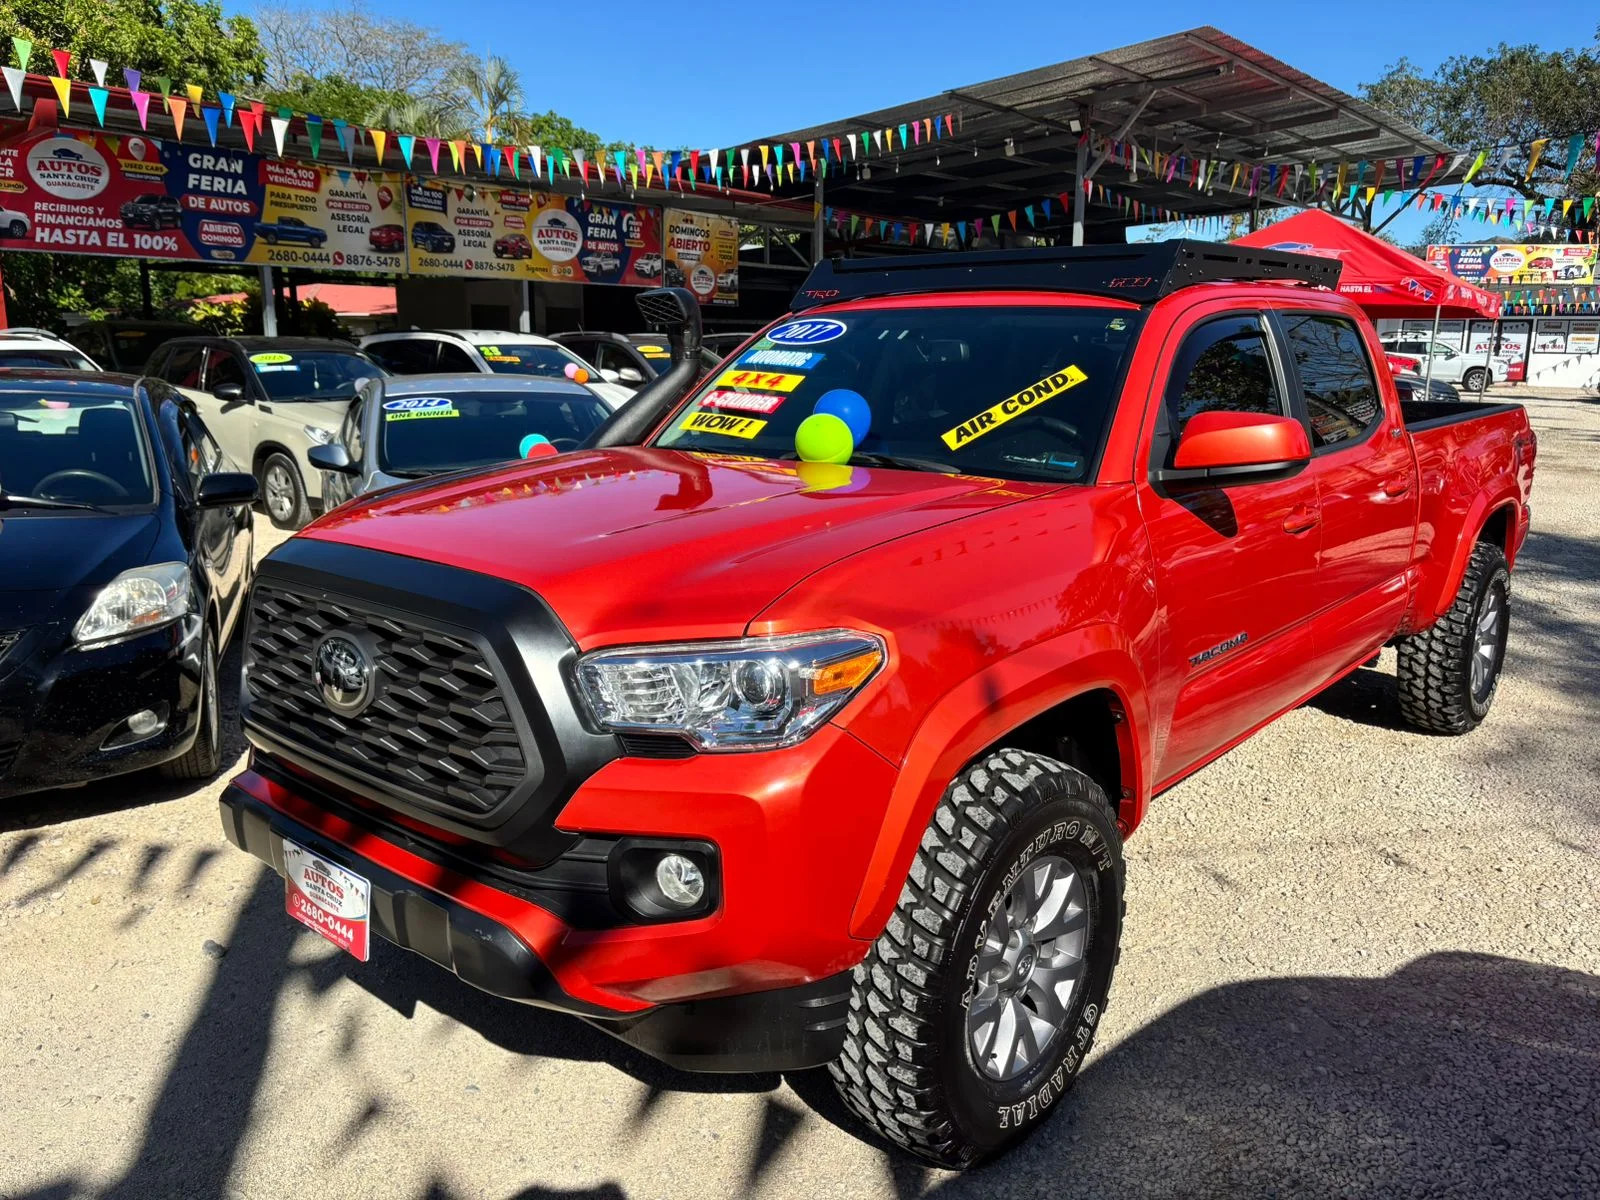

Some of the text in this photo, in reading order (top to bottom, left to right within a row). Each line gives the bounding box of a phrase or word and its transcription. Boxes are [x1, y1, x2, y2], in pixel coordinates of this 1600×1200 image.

[36, 160, 102, 177] AUTOS
[188, 153, 243, 175] GRAN
[40, 173, 100, 184] SANTA CRUZ
[298, 170, 314, 180] 100
[46, 181, 96, 191] GUANACASTE
[188, 174, 247, 195] FERIA
[270, 192, 317, 204] PARA TODO
[329, 189, 367, 201] GARANTÍA
[35, 202, 105, 215] RECIBIMOS Y
[189, 197, 251, 213] DE AUTOS
[270, 200, 318, 212] PRESUPUESTO
[343, 203, 370, 212] ESCRITO
[331, 212, 370, 224] ASESORÍA
[457, 207, 490, 217] GARANTÍA
[35, 213, 123, 229] FINANCIAMOS
[588, 213, 617, 226] GRAN
[203, 223, 240, 235] ABIERTO
[337, 225, 365, 235] LEGAL
[458, 229, 492, 239] ASESORÍA
[537, 229, 578, 242] AUTOS
[588, 227, 618, 240] FERIA
[669, 225, 710, 238] DOMINGOS
[35, 227, 179, 252] HASTA EL 100%
[201, 234, 243, 244] DOMINGOS
[463, 240, 487, 249] LEGAL
[668, 237, 711, 252] ABIERTO
[588, 241, 597, 250] DE
[598, 242, 619, 252] AUTOS
[268, 249, 401, 268] 2680-0444 8876-5478
[419, 258, 515, 272] 2680-0444 8876-5478
[1340, 285, 1360, 293] HASTA
[1360, 285, 1373, 293] EL
[771, 324, 839, 340] 2017
[745, 350, 813, 368] AUTOMATIC
[397, 399, 440, 410] 2014
[954, 372, 1076, 445] AIR COND.
[391, 410, 454, 420] ONE OWNER
[1188, 631, 1249, 668] TACOMA
[304, 868, 344, 900] AUTOS
[305, 882, 343, 908] SANTA CRUZ
[301, 899, 354, 943] 2680-0444
[961, 820, 1113, 1011] ADVENTURO M/T
